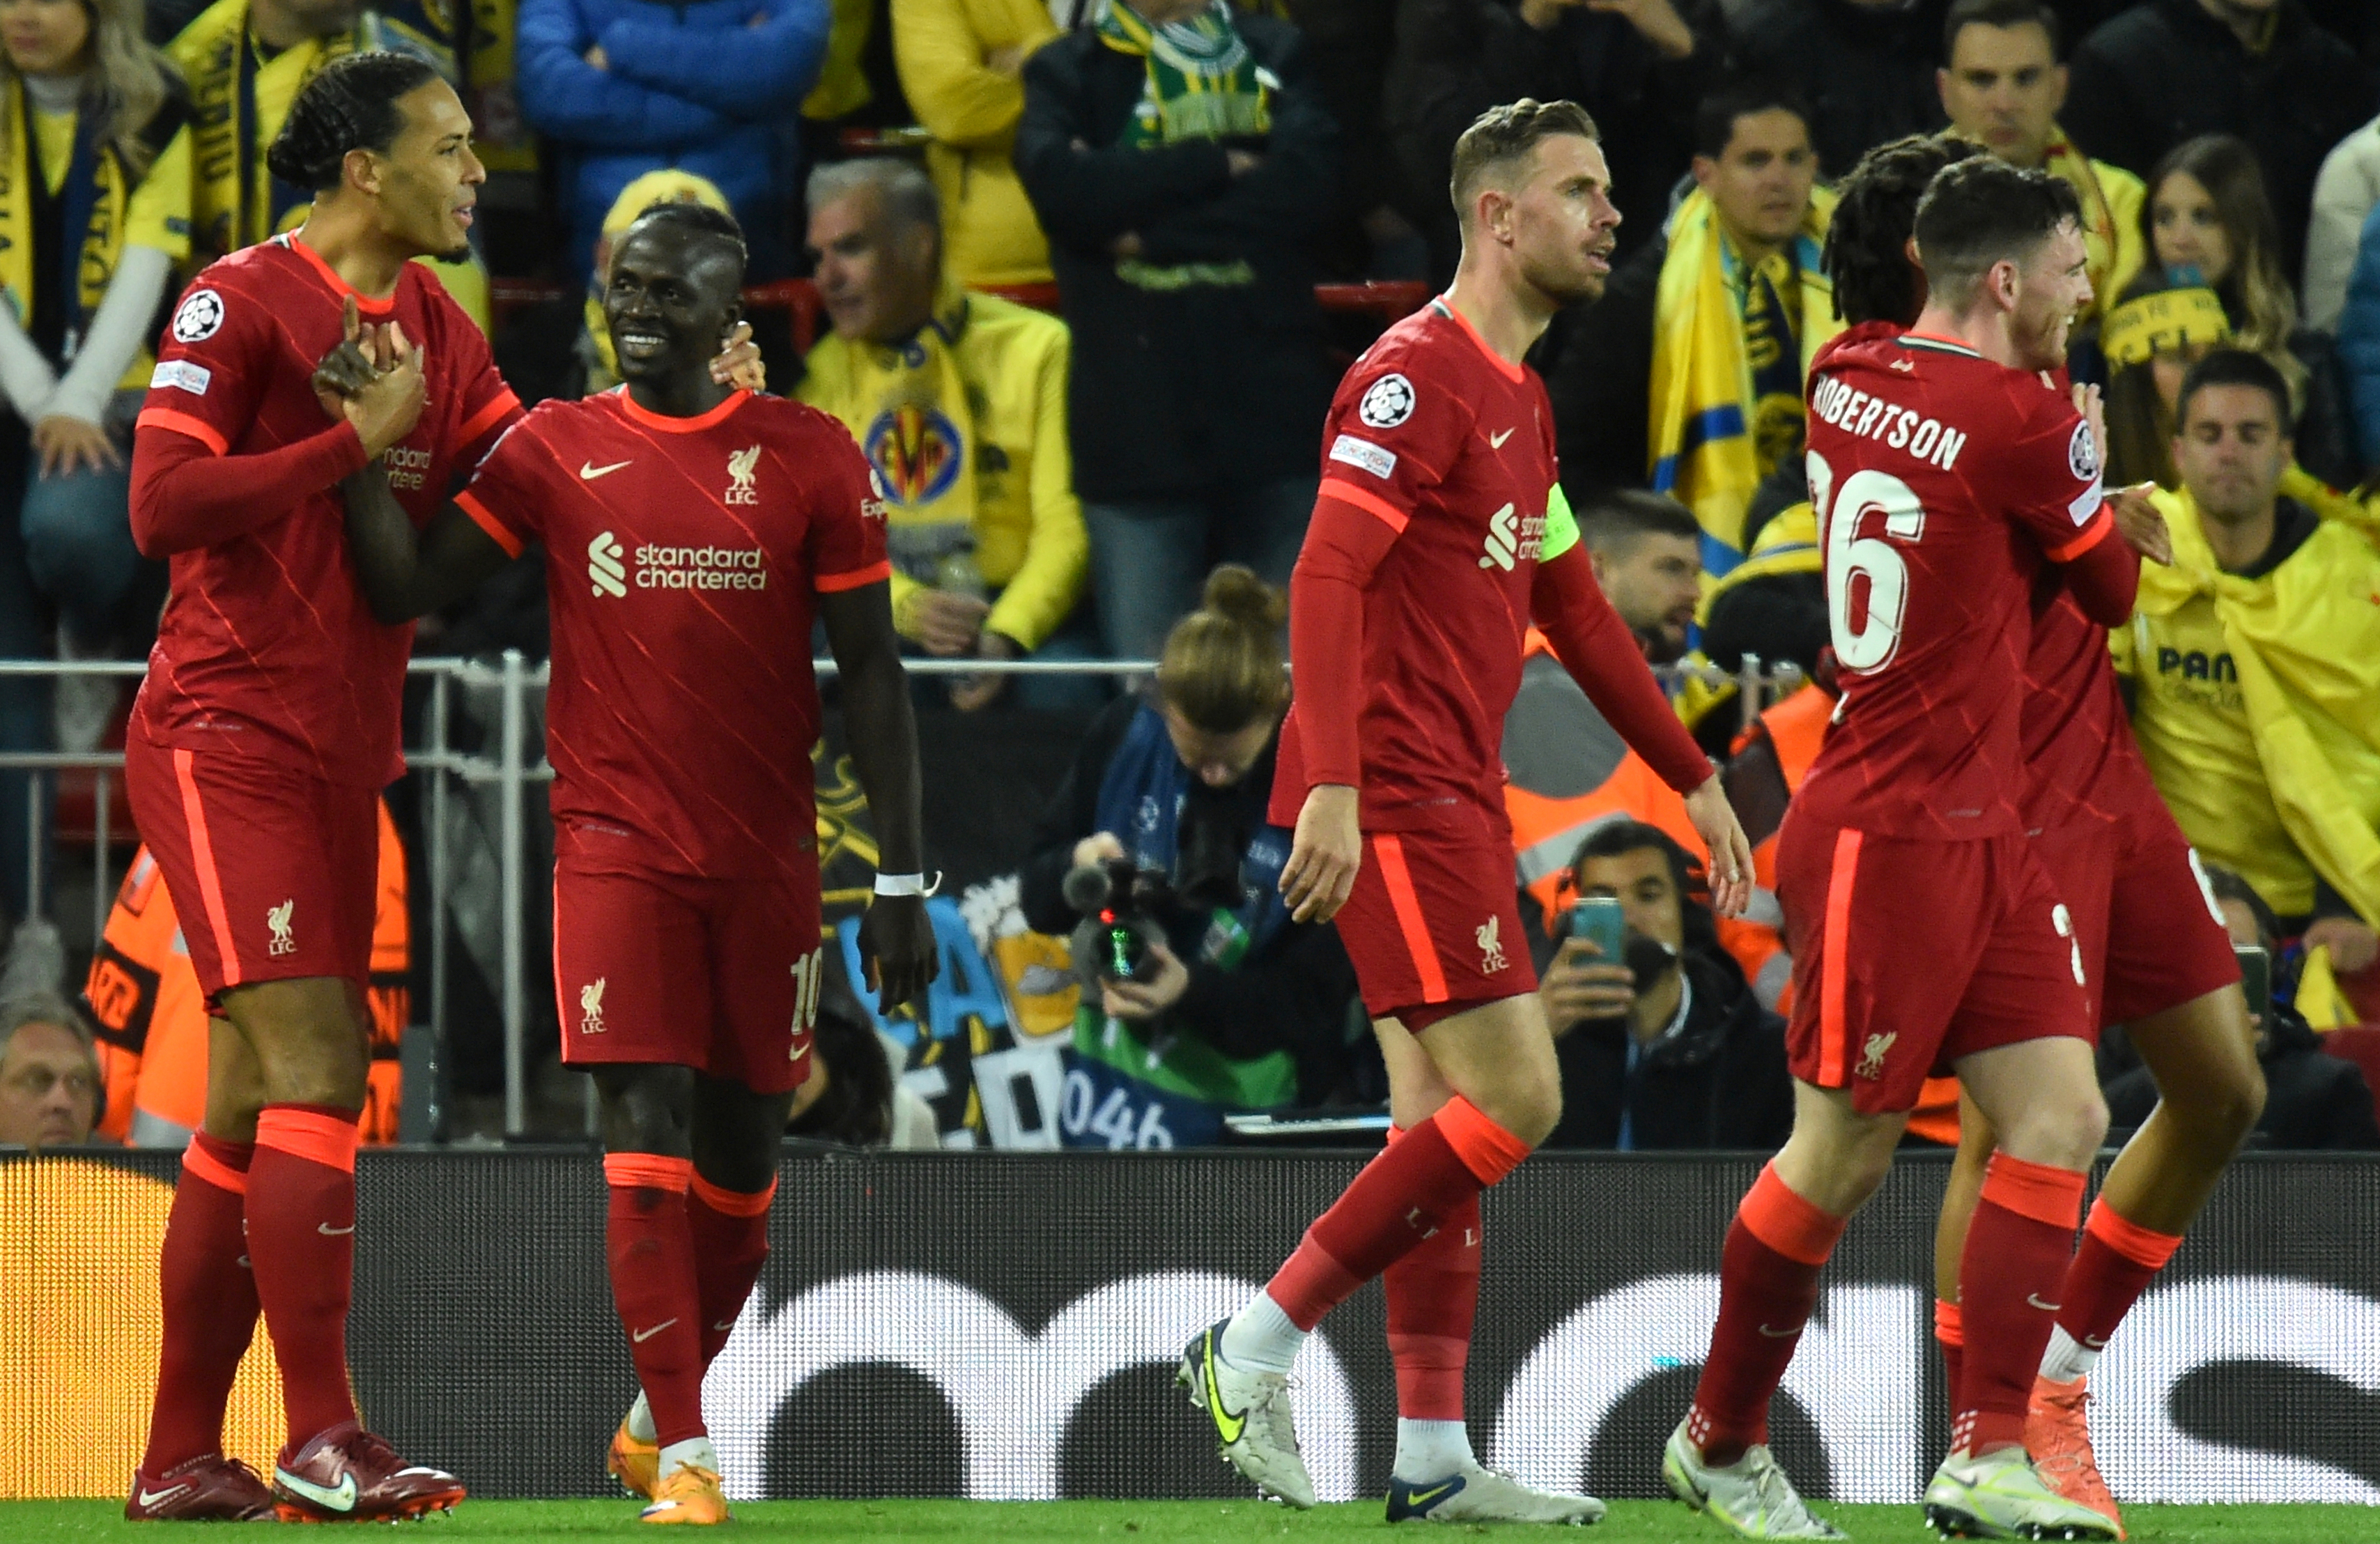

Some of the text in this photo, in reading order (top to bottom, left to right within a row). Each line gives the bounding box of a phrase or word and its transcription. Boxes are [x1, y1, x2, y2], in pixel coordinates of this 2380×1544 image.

[1813, 373, 1967, 471] ROBERTSON
[384, 446, 431, 469] ndard
[635, 543, 761, 569] standard
[635, 567, 766, 591] chartered
[791, 946, 822, 1035] 10
